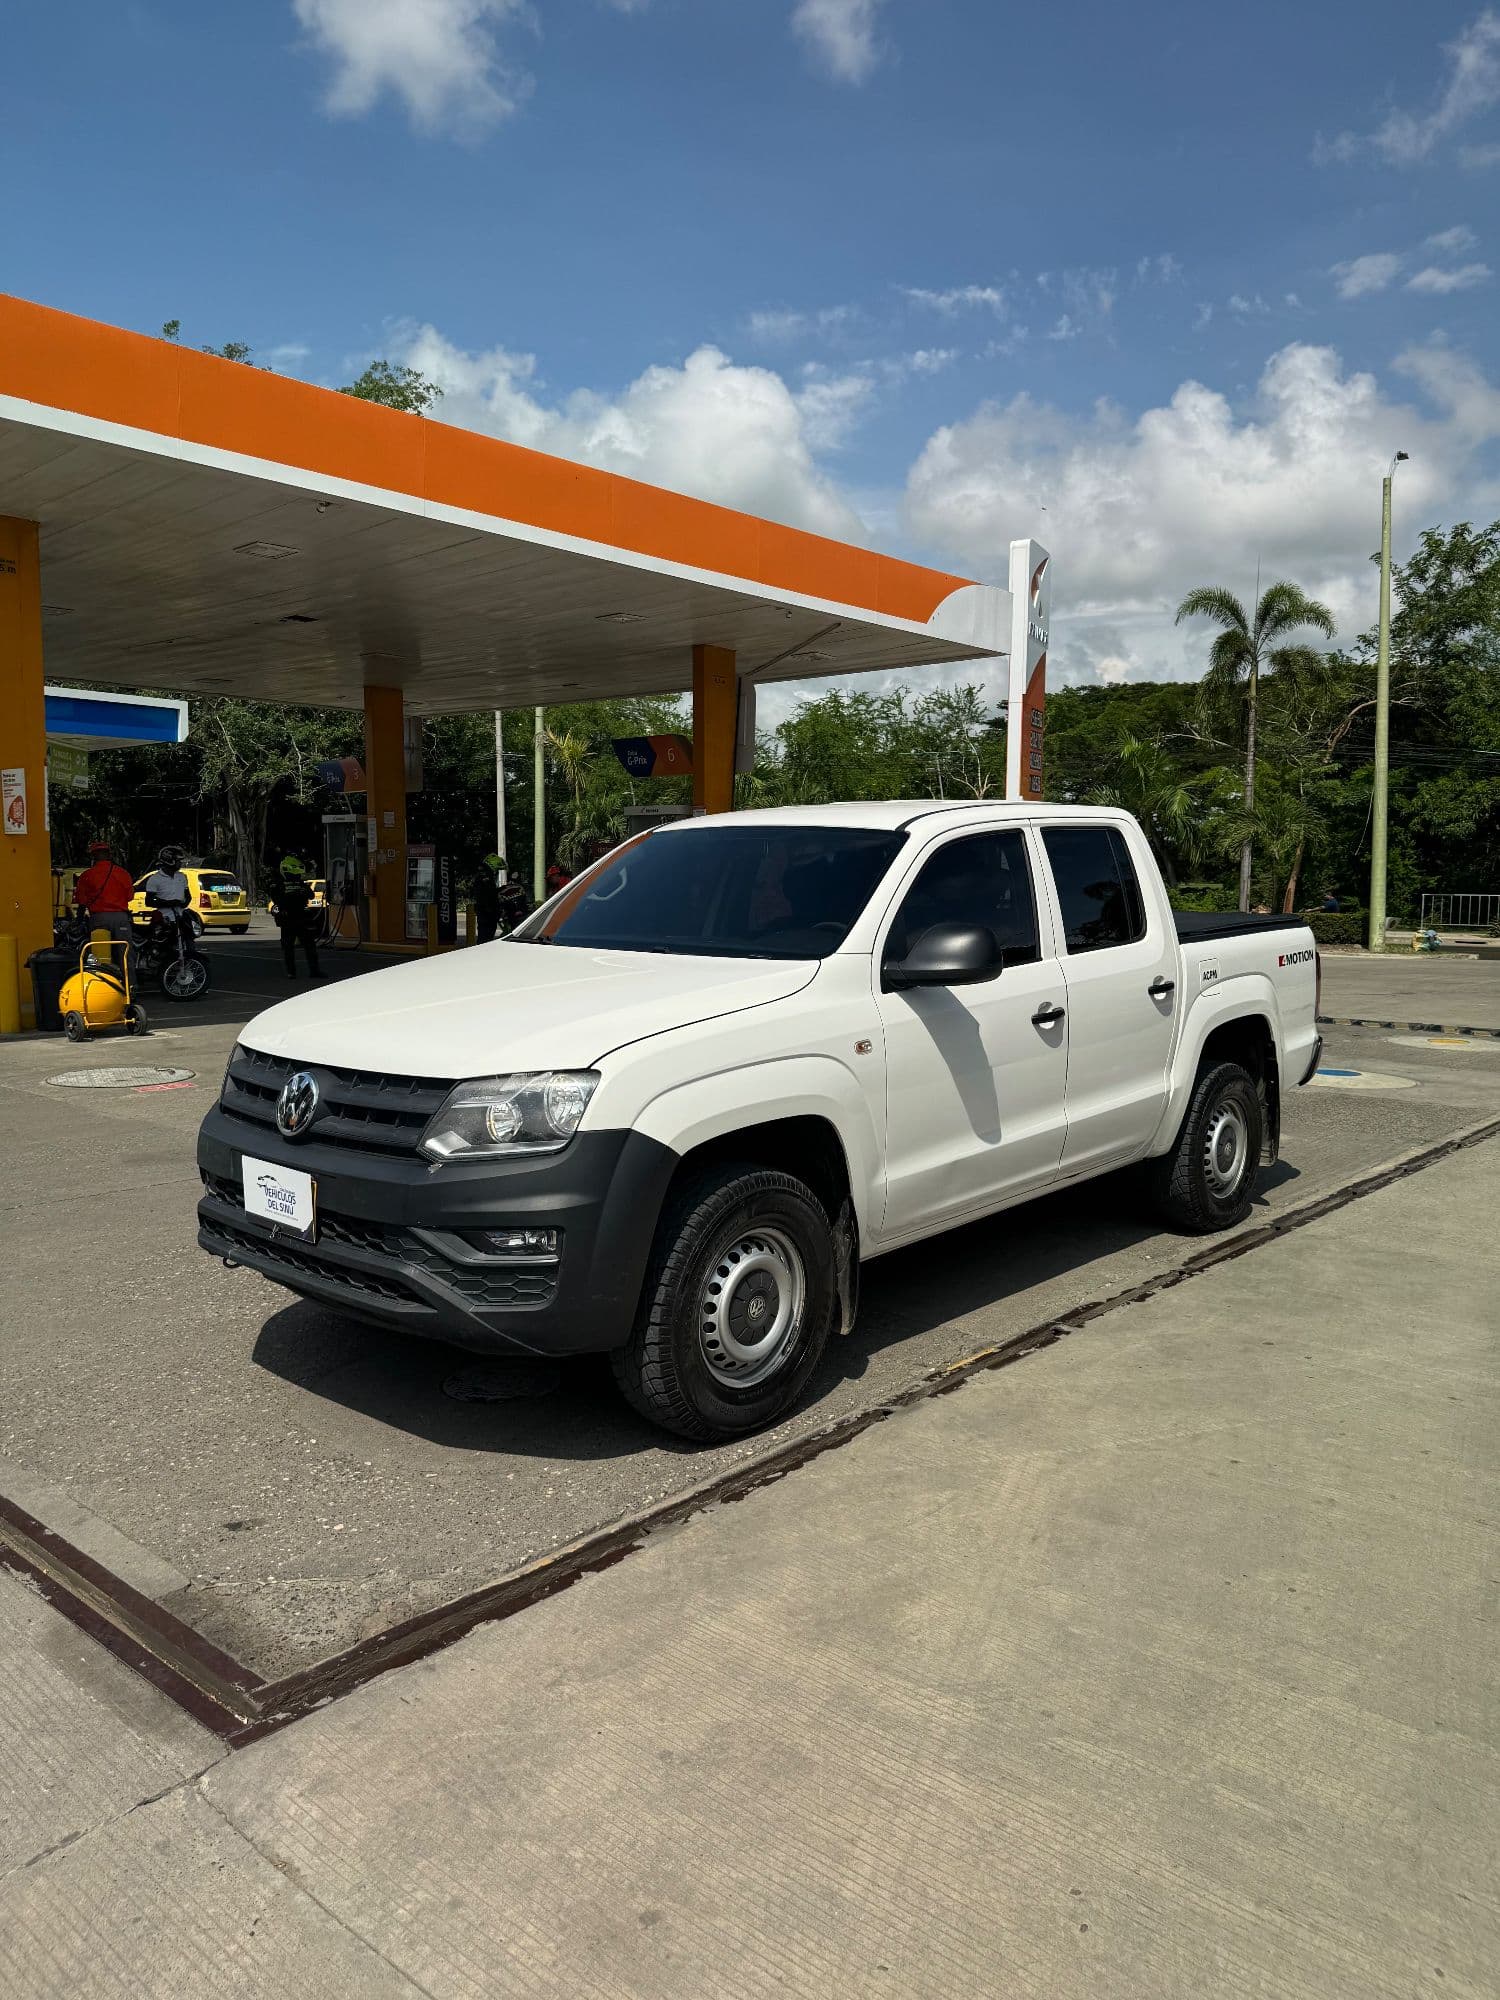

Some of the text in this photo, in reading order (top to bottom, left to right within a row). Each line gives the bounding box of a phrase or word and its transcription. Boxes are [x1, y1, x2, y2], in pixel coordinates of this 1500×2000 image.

[667, 748, 675, 762] 6
[440, 857, 450, 924] distracom
[267, 1198, 279, 1211] DEL
